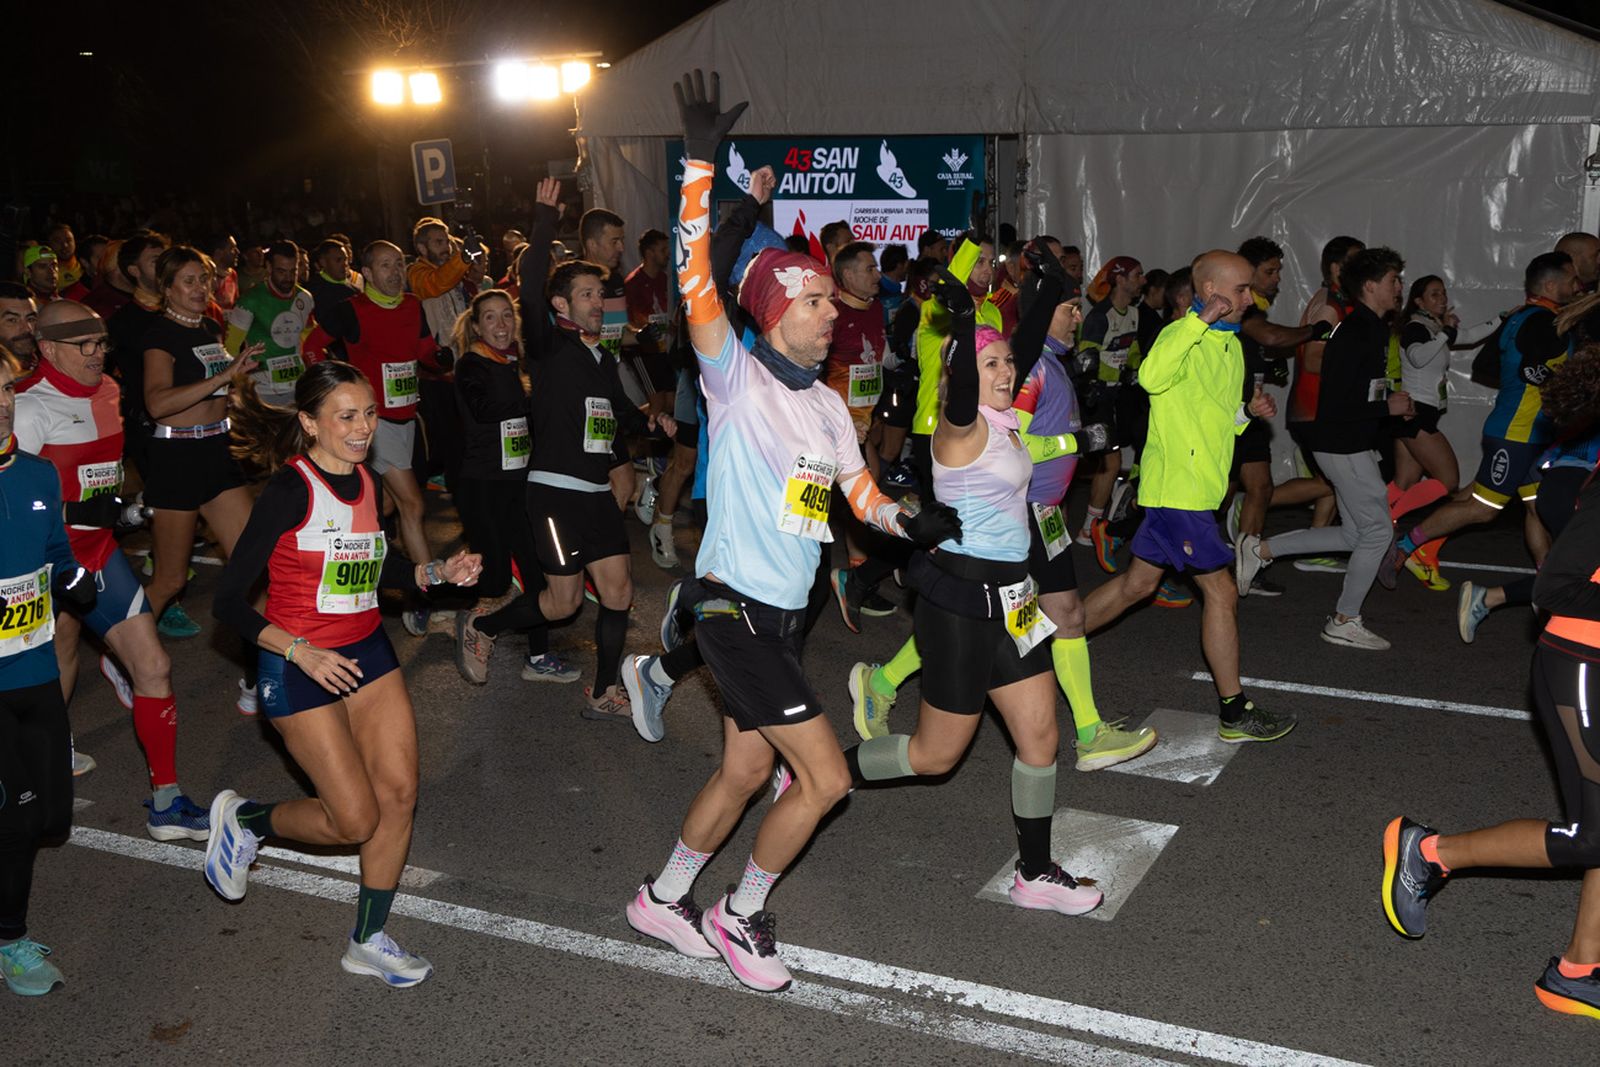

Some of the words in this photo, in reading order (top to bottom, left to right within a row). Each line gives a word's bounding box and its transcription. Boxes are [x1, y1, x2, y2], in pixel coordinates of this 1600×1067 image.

[784, 147, 812, 171] 43
[812, 147, 859, 169] SAN
[422, 148, 446, 196] P
[778, 167, 855, 194] ANTÓN
[888, 172, 904, 189] 43
[852, 225, 886, 240] SAN
[795, 471, 812, 481] SAN
[343, 542, 363, 550] NOCHE
[364, 541, 371, 549] DE
[334, 552, 349, 560] SAN
[336, 561, 378, 586] 9020
[0, 583, 25, 595] NOCHE
[2, 597, 44, 631] 2276
